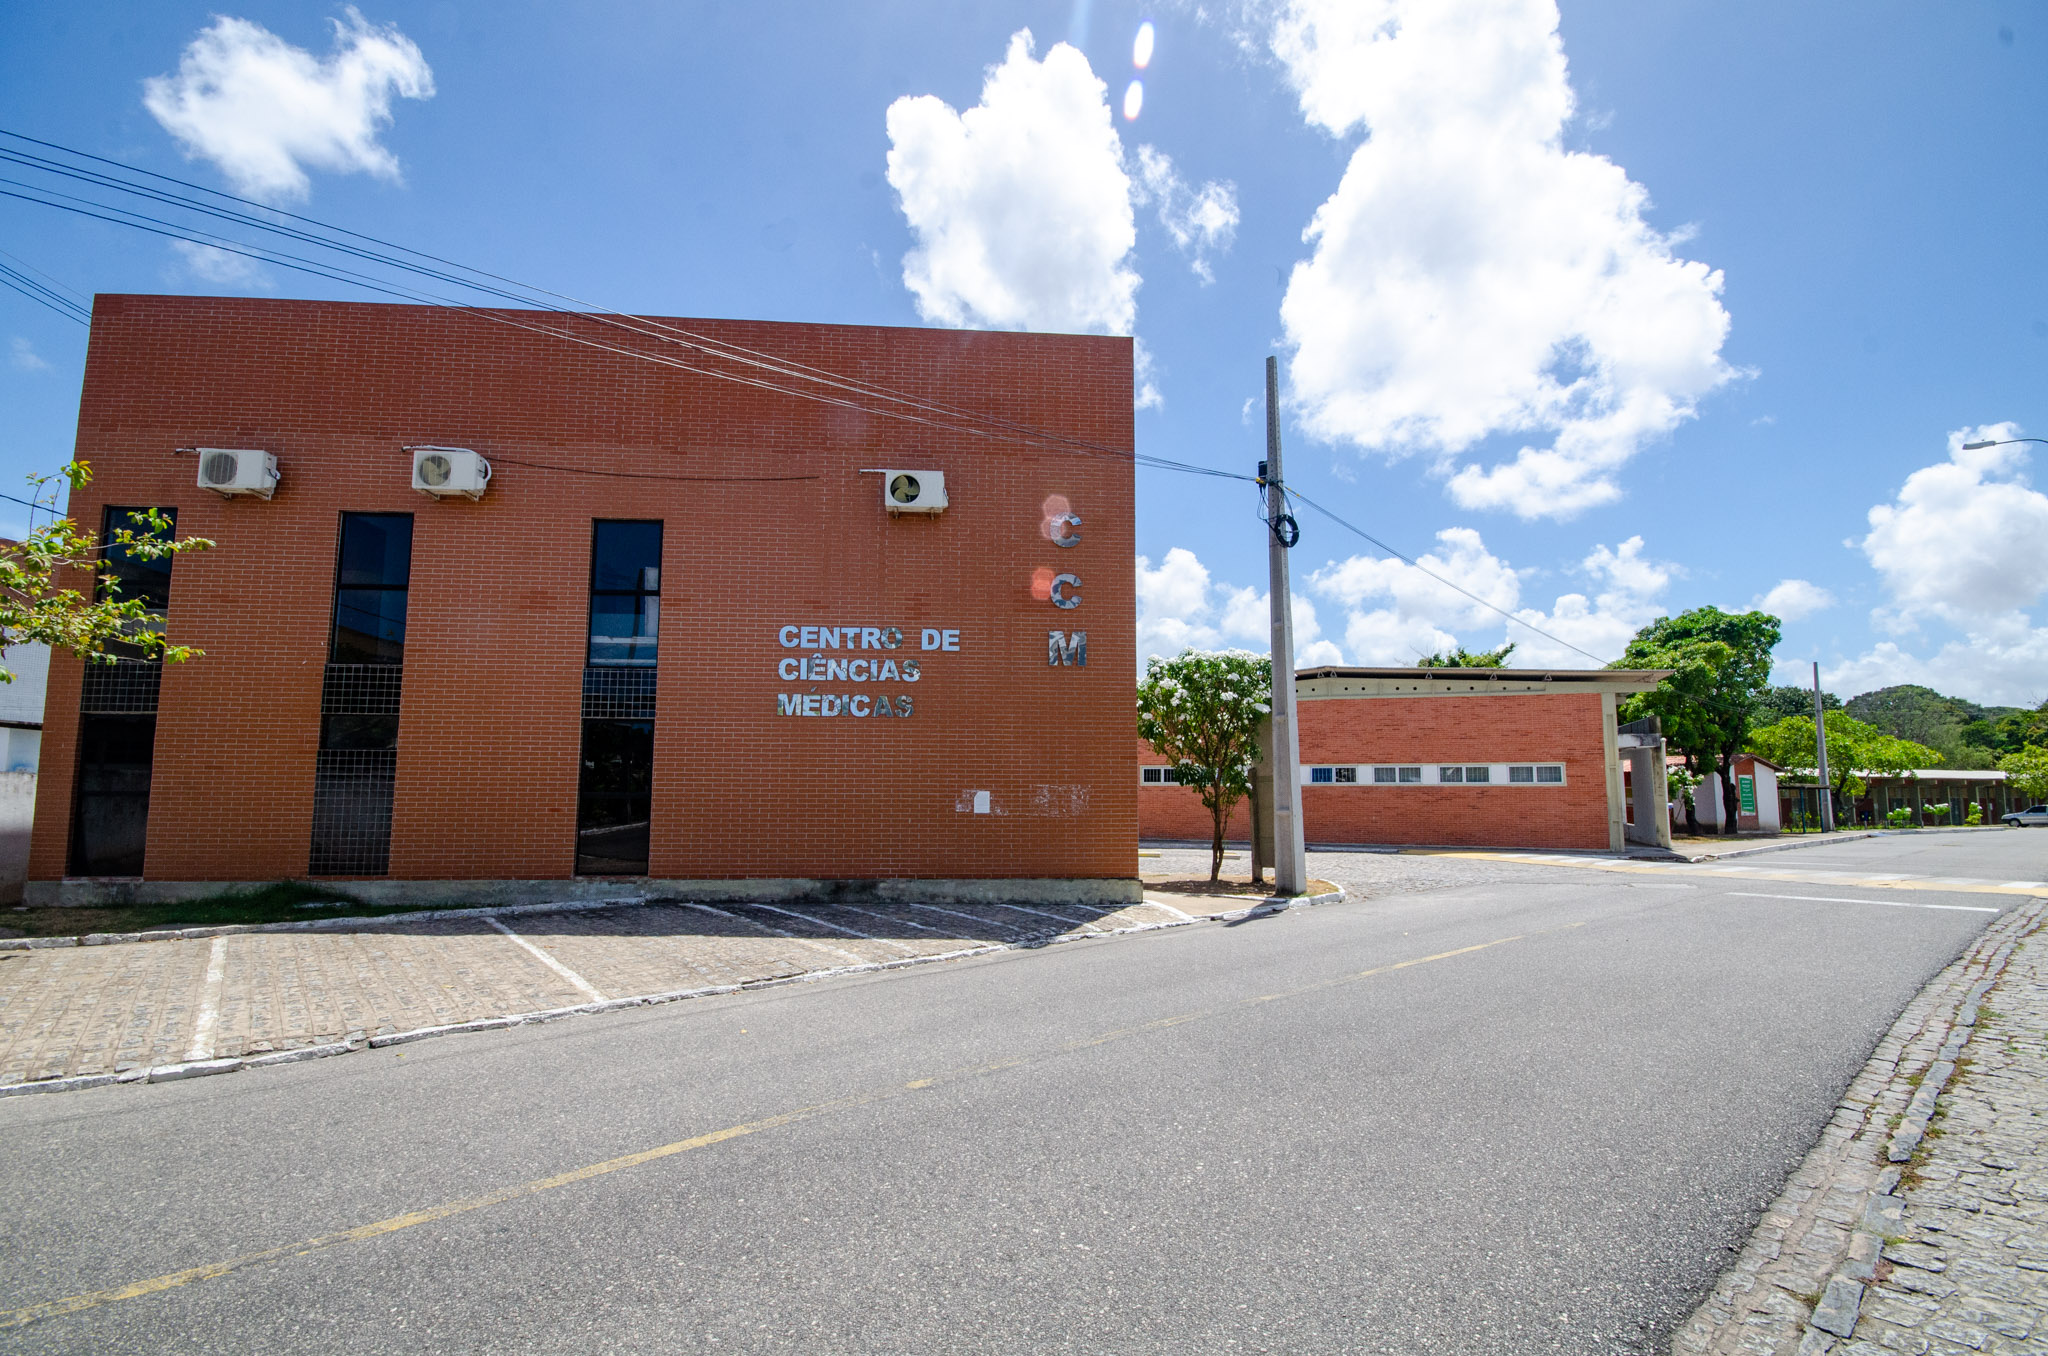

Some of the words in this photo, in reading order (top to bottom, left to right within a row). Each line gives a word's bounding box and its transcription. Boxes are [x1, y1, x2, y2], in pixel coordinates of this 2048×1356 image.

[779, 625, 903, 649] CENTRO
[921, 628, 960, 651] DE
[778, 653, 921, 682] CIÊNCIAS
[777, 686, 914, 718] MÉDICAS
